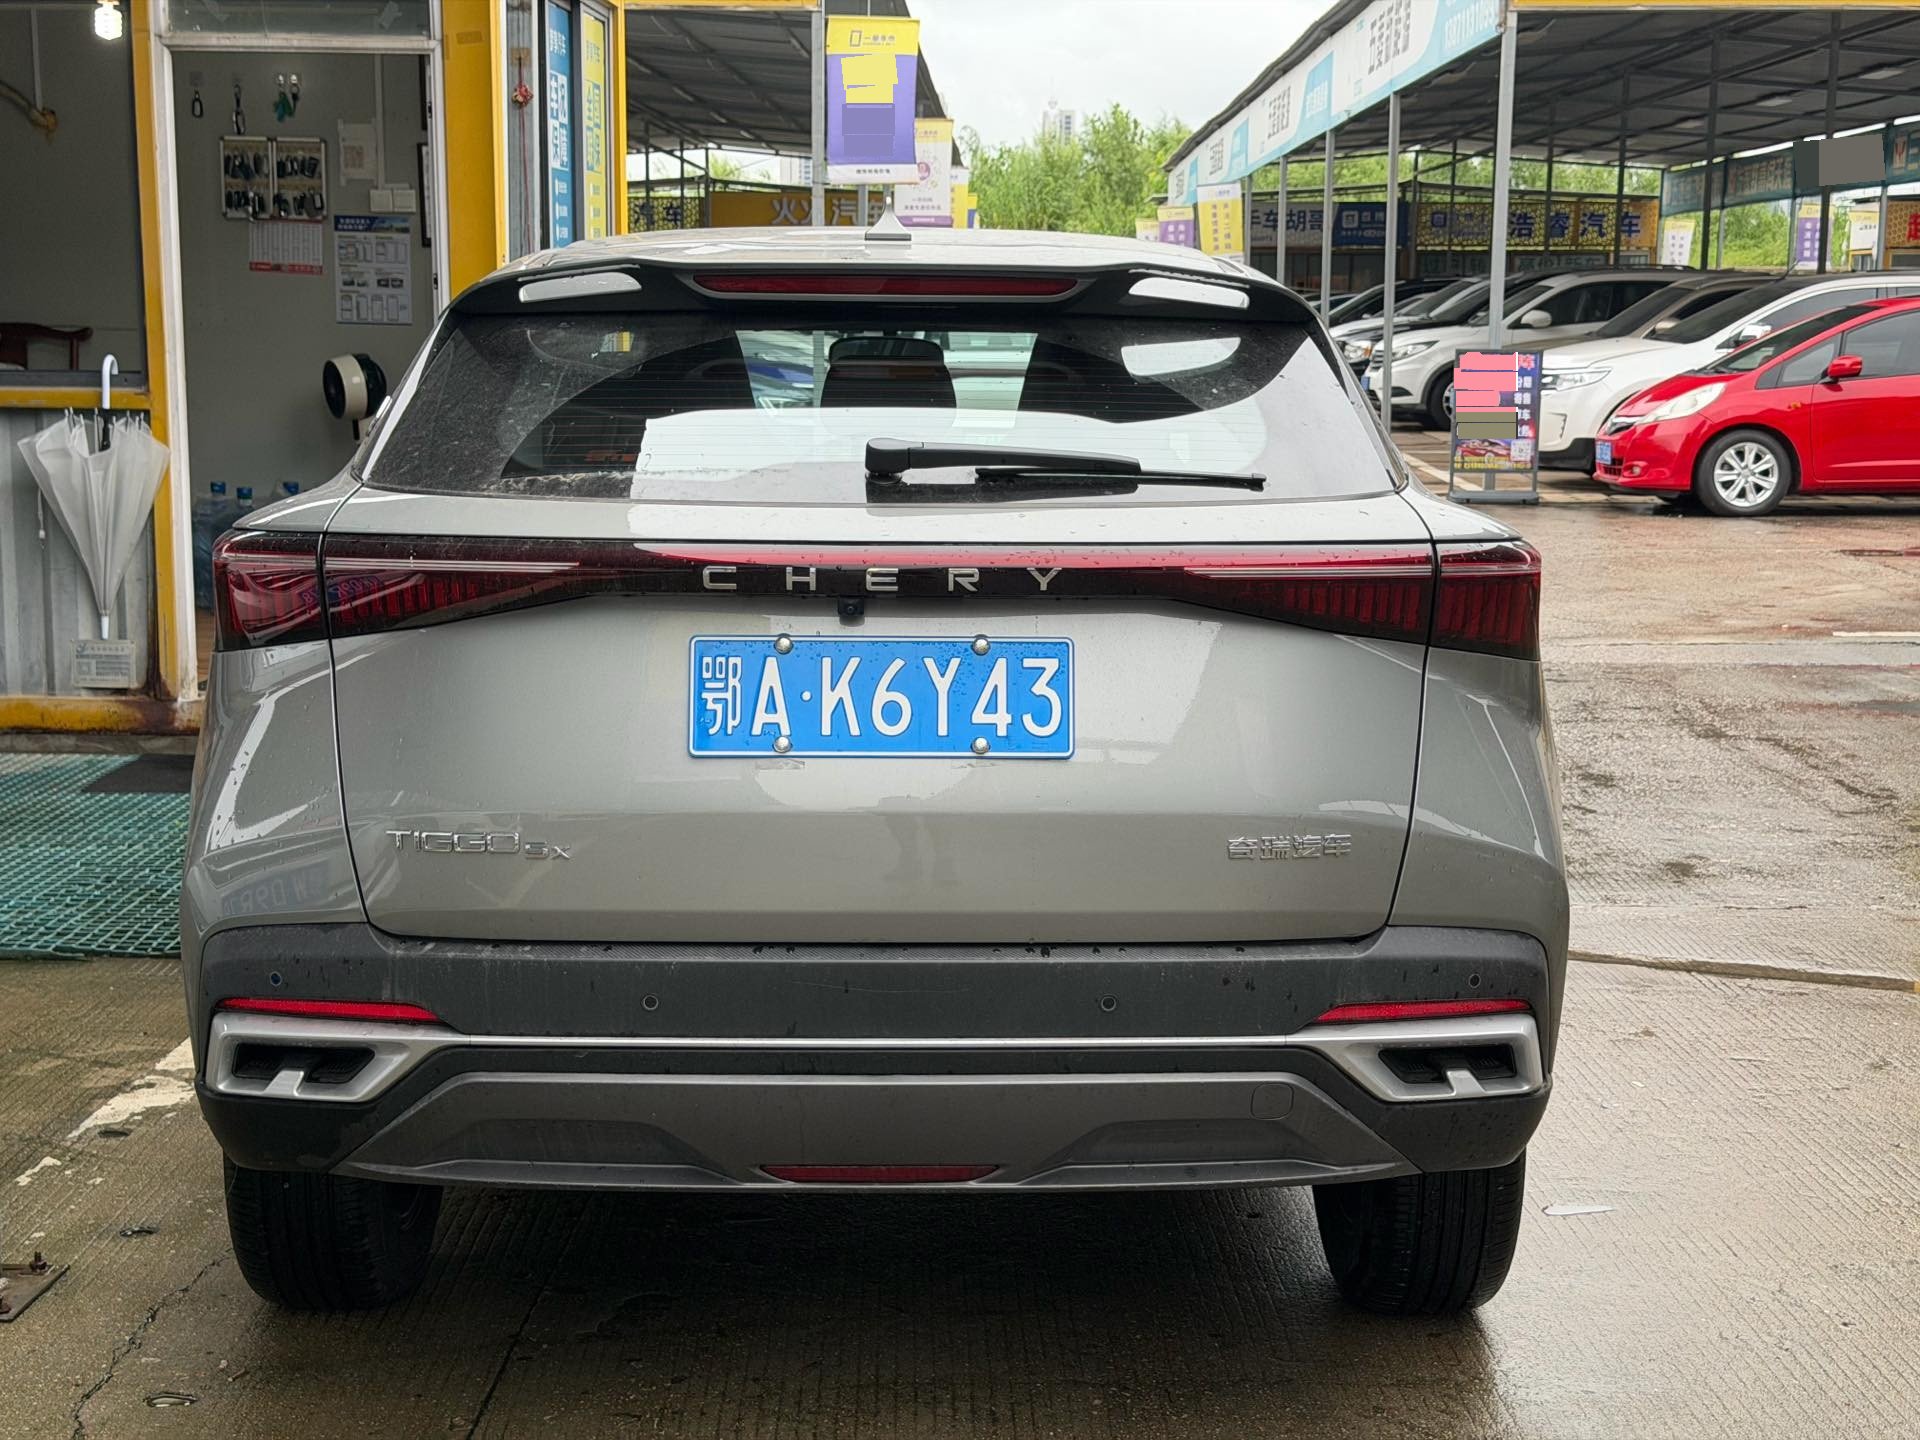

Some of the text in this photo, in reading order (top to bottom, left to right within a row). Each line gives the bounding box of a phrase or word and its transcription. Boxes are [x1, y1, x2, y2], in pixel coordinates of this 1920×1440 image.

[702, 565, 1062, 592] CHERY
[701, 655, 1063, 738] 鄂A·K6Y43
[386, 830, 520, 854] TIGGO
[1228, 834, 1352, 860] 奇瑞汽车
